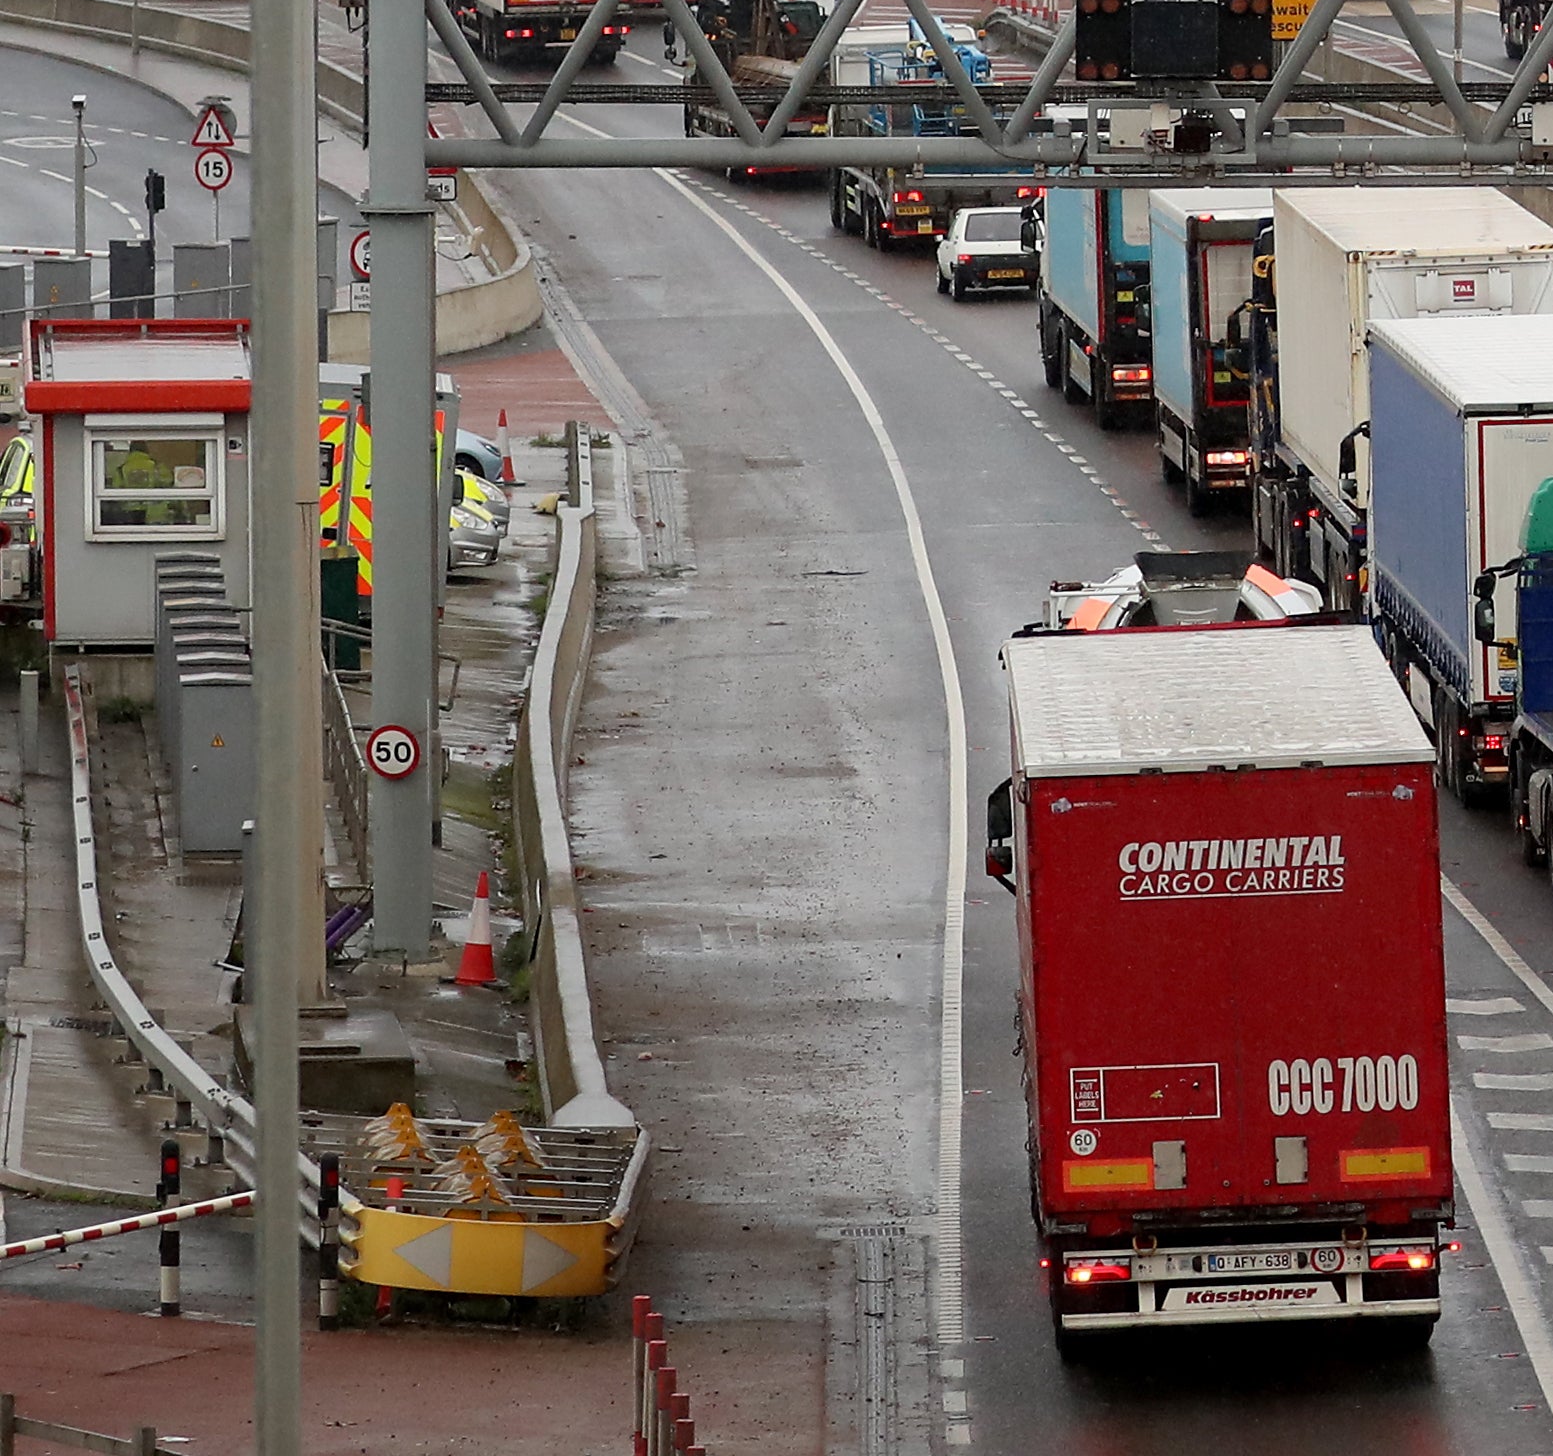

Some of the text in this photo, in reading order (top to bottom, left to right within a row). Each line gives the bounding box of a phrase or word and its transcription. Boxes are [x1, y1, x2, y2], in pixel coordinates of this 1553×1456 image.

[203, 161, 223, 178] 15
[376, 742, 411, 763] 50
[1118, 835, 1345, 873] CONTINENTAL
[1119, 867, 1345, 895] CARGO CARRIERS
[1268, 1054, 1418, 1116] CCC 7000
[1074, 1134, 1092, 1146] 60
[1318, 1245, 1336, 1262] 60
[1186, 1287, 1318, 1304] Kässbohrer
